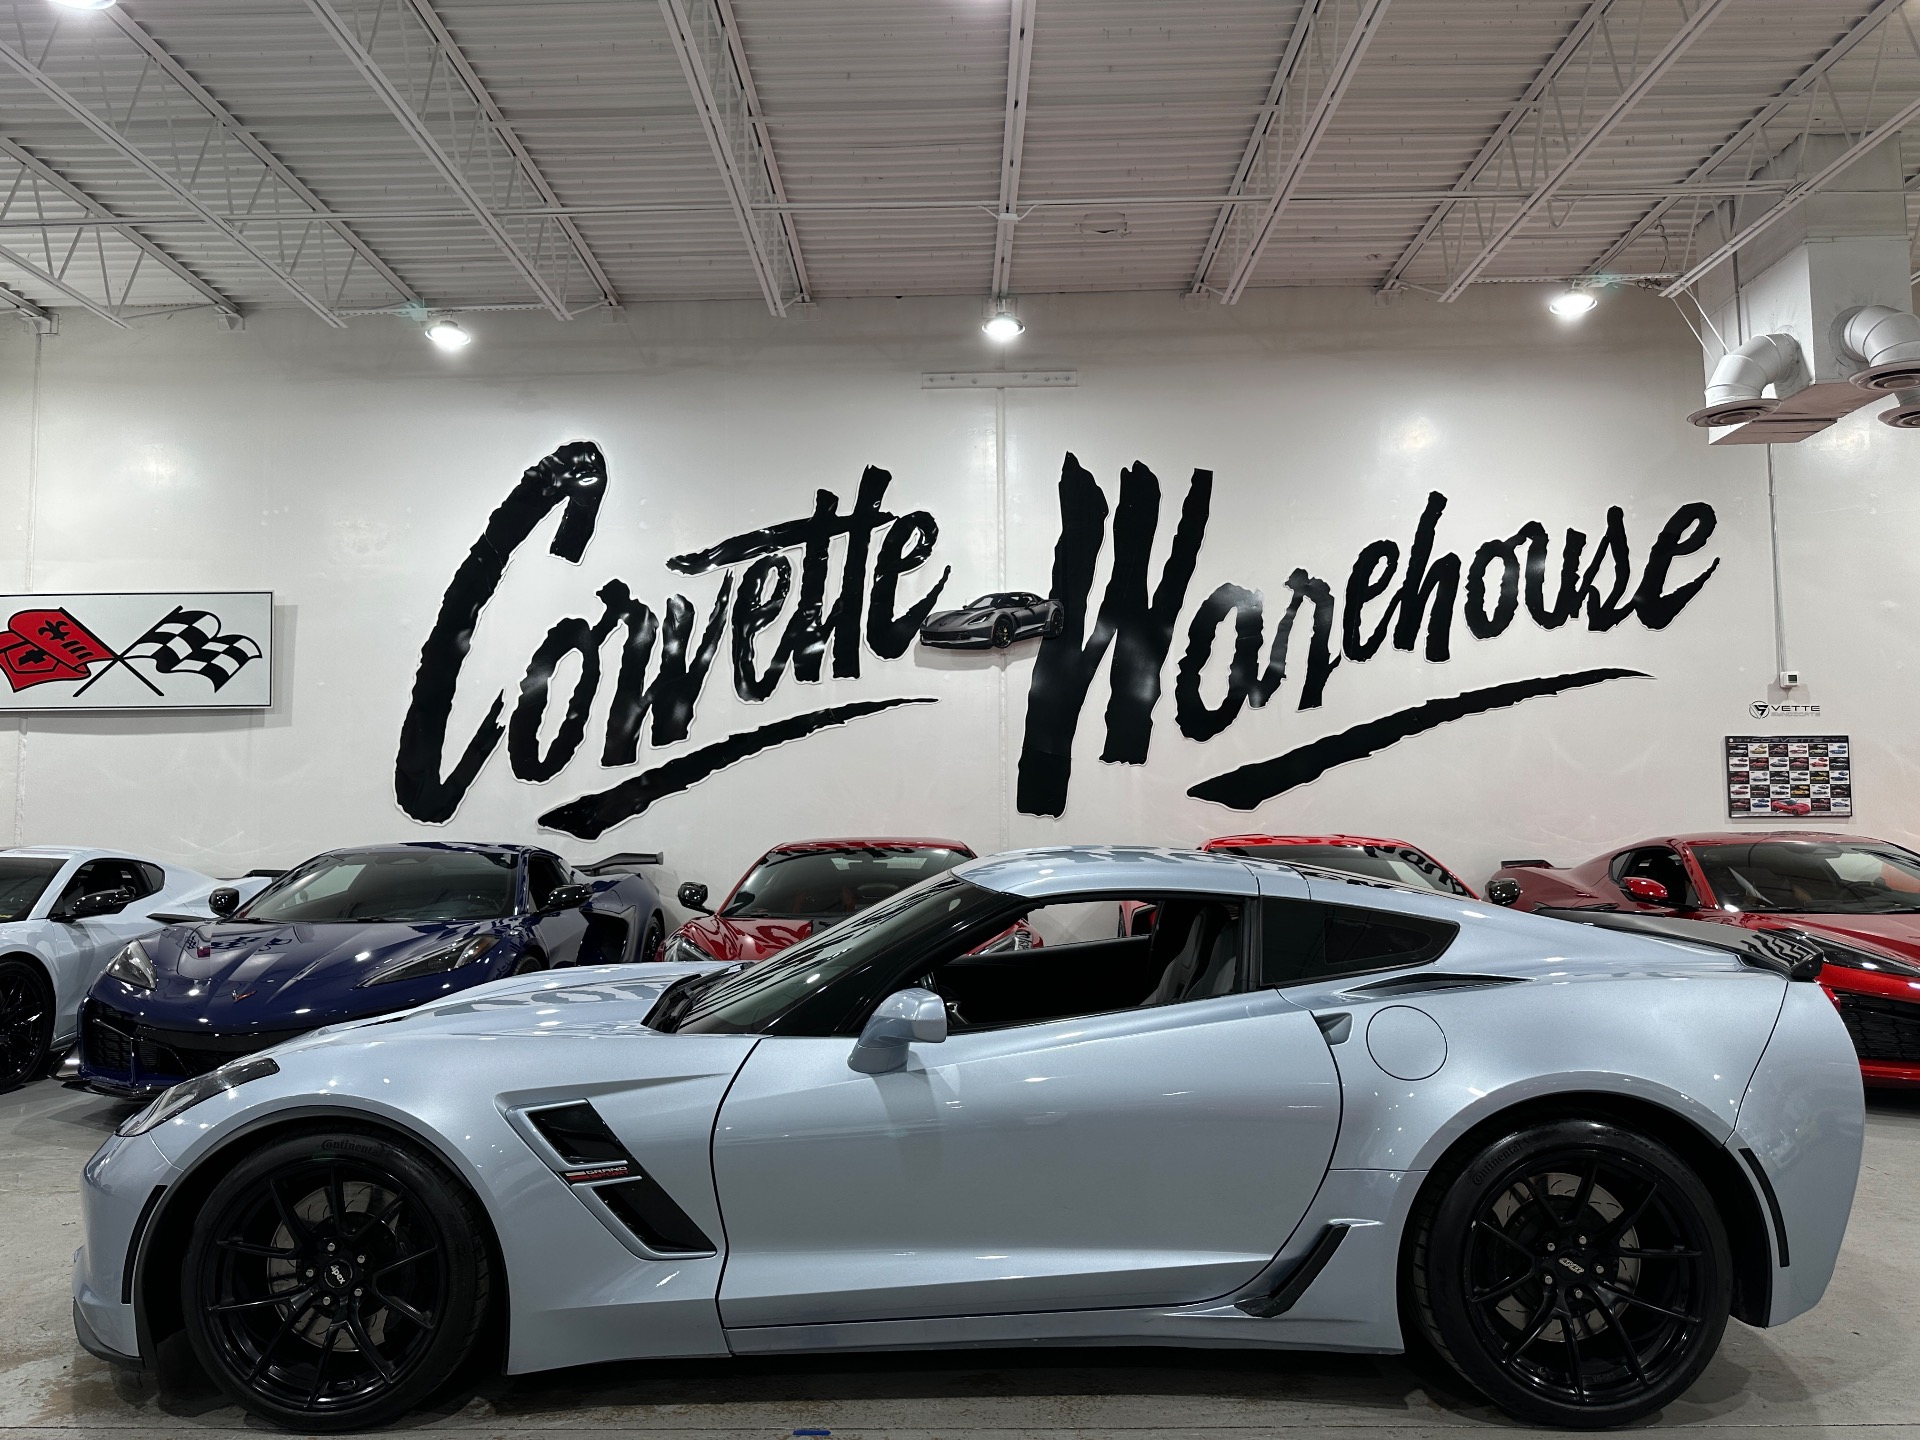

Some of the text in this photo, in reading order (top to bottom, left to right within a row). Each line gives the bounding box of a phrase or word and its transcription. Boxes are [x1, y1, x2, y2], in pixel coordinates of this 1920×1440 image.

[395, 441, 1720, 825] Corvette Warehouse
[586, 1166, 627, 1175] GRAND
